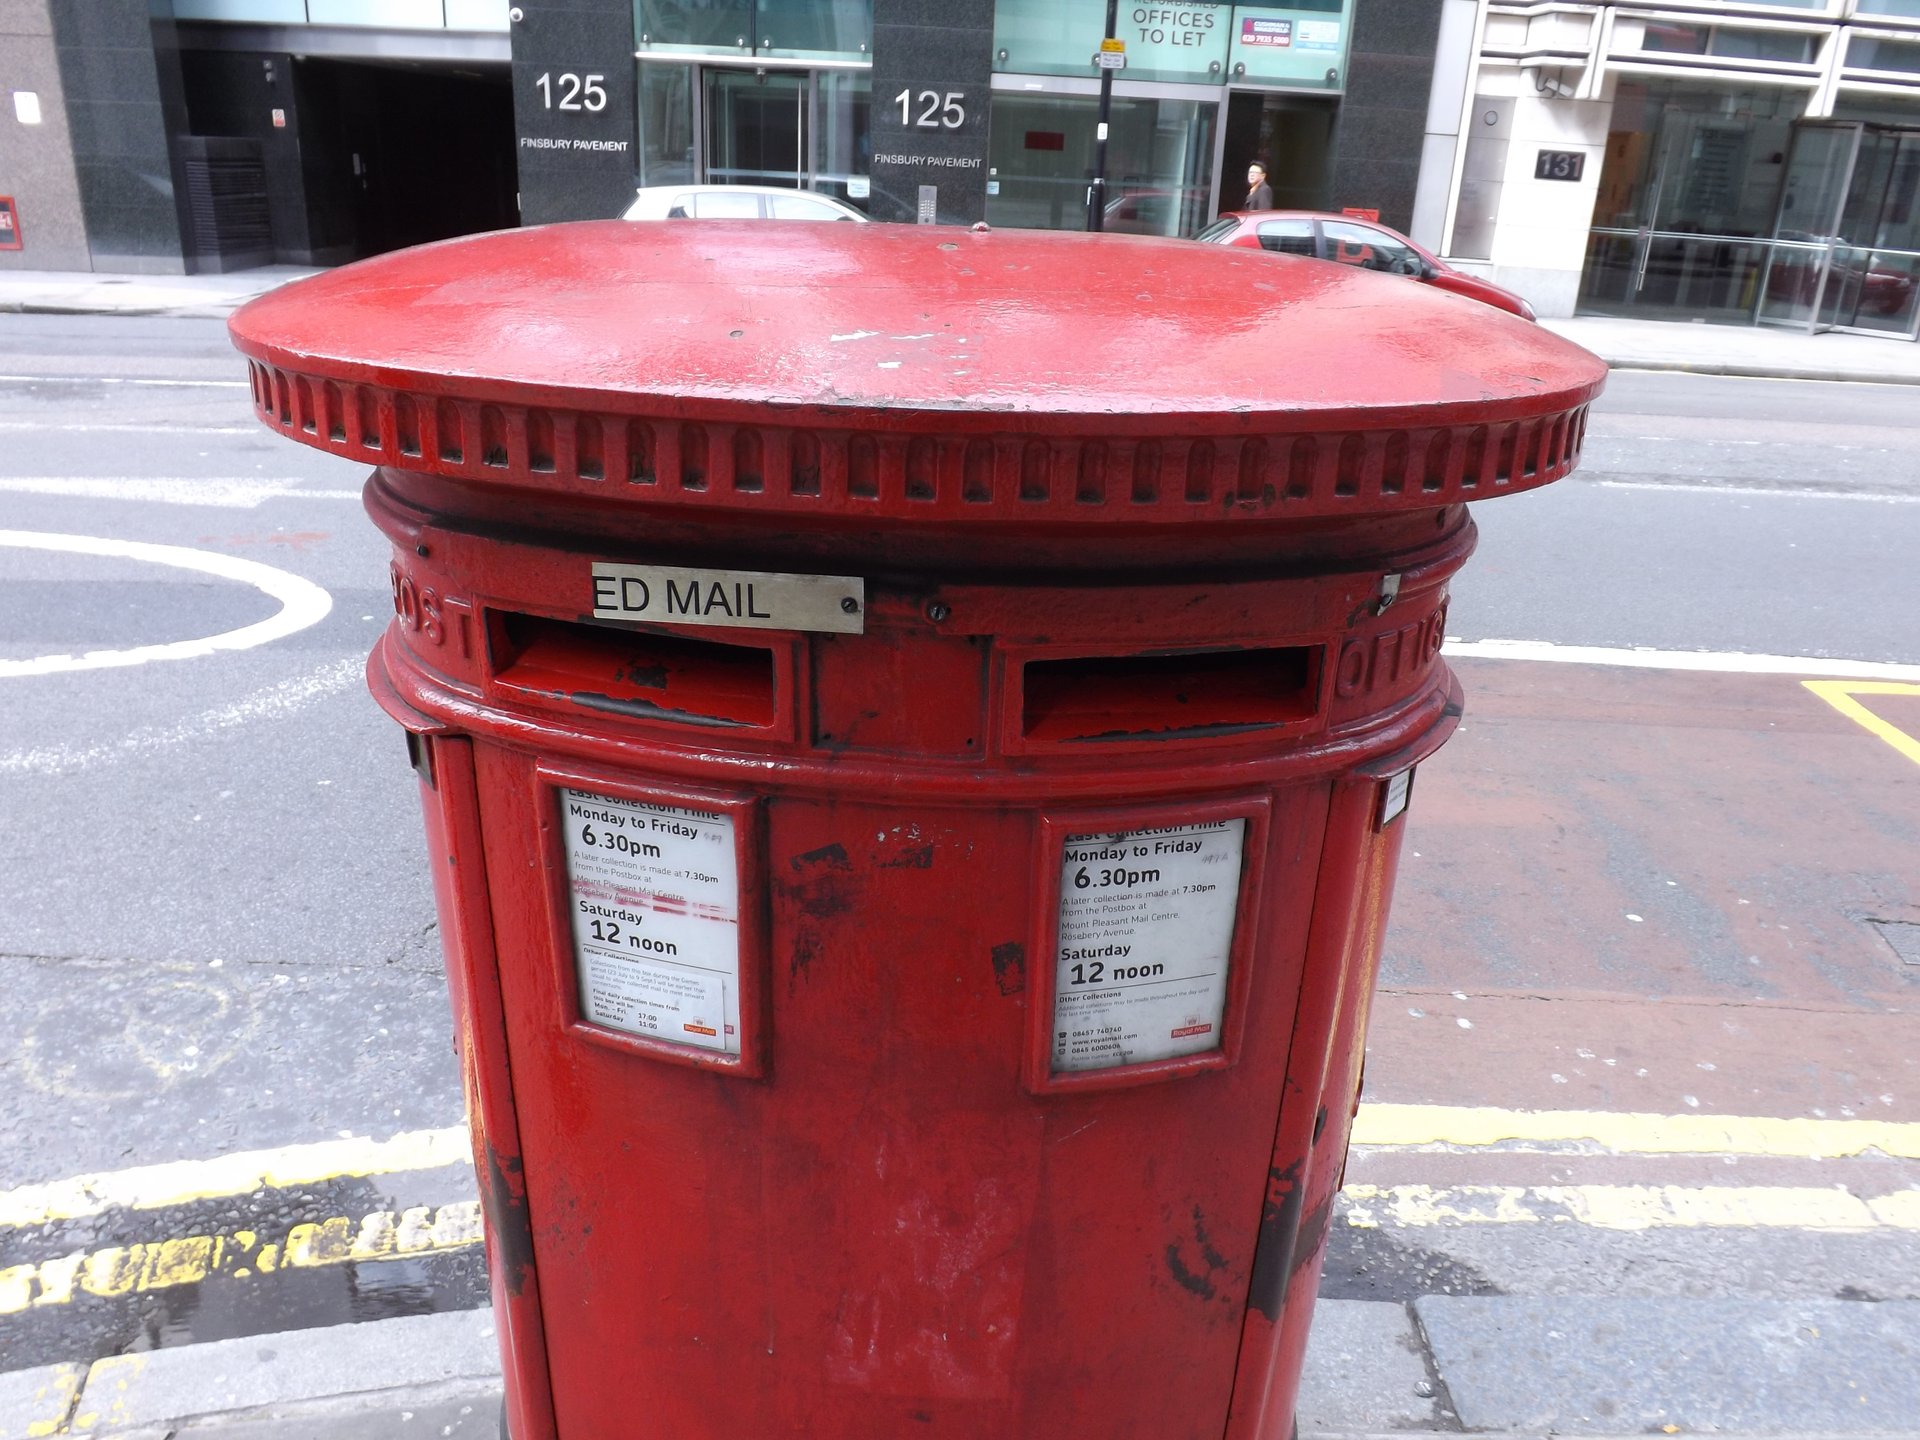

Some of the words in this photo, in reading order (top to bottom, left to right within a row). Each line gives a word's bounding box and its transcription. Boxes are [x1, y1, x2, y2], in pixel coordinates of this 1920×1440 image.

[1133, 9, 1215, 28] OFFICES
[1139, 28, 1164, 44] TO
[1172, 31, 1206, 46] LET
[536, 72, 606, 111] 125
[895, 89, 965, 128] 125
[520, 137, 572, 149] FINSBURY
[573, 140, 628, 152] PAVEMENT
[874, 153, 926, 166] FINSBURY
[927, 156, 982, 168] PAVEMENT
[1541, 152, 1582, 178] 131
[666, 579, 770, 618] MAIL
[570, 804, 626, 828] Monday
[632, 816, 646, 829] to
[652, 819, 698, 840] Friday
[582, 824, 661, 858] 6.30pm
[1065, 848, 1126, 864] Monday
[1133, 846, 1148, 857] to
[1154, 840, 1202, 855] Friday
[575, 862, 594, 872] from
[596, 864, 609, 875] the
[611, 869, 642, 882] Postbox
[644, 875, 652, 883] at
[582, 852, 599, 862] later
[602, 855, 638, 870] collection
[640, 864, 646, 872] is
[650, 866, 672, 876] made
[674, 870, 682, 878] at
[685, 870, 718, 884] 7.30pm
[1074, 866, 1160, 888] 6.30pm
[576, 874, 601, 886] Mount
[604, 879, 636, 894] Pleasant
[639, 886, 656, 896] Mail
[577, 885, 612, 900] Rosebery
[1071, 896, 1091, 906] later
[1094, 892, 1133, 904] collection
[1136, 891, 1142, 900] is
[1146, 888, 1168, 898] made
[1172, 888, 1180, 896] at
[1182, 884, 1216, 894] 7.30pm
[580, 900, 642, 926] Saturday
[1062, 906, 1082, 916] from
[1086, 906, 1098, 914] the
[1102, 904, 1136, 914] Postbox
[1138, 902, 1147, 910] at
[1062, 920, 1089, 930] Mount
[1092, 916, 1128, 927] Pleasant
[1131, 914, 1148, 924] Mail
[590, 918, 621, 944] 12
[629, 934, 678, 956] noon
[1062, 930, 1100, 941] Rosebery
[584, 947, 602, 956] Other
[604, 950, 640, 964] Collections
[1061, 944, 1131, 961] Saturday
[1070, 962, 1104, 985] 12
[1113, 962, 1164, 981] noon
[593, 988, 606, 996] Final
[608, 991, 620, 1000] daily
[622, 994, 648, 1006] collection
[1060, 994, 1080, 1004] Other
[1082, 991, 1122, 1002] Collections
[595, 1010, 624, 1023] Saturday
[638, 1020, 658, 1030] 11:00
[638, 1012, 658, 1022] 17:00
[685, 1024, 700, 1034] Royal
[702, 1028, 715, 1036] Mail
[1072, 1028, 1095, 1038] 08457
[1096, 1026, 1122, 1035] 740740
[1172, 1028, 1194, 1037] Royal
[1194, 1024, 1211, 1034] Mail
[1071, 1033, 1138, 1046] www.royalmail.com
[1071, 1046, 1089, 1054] 0845
